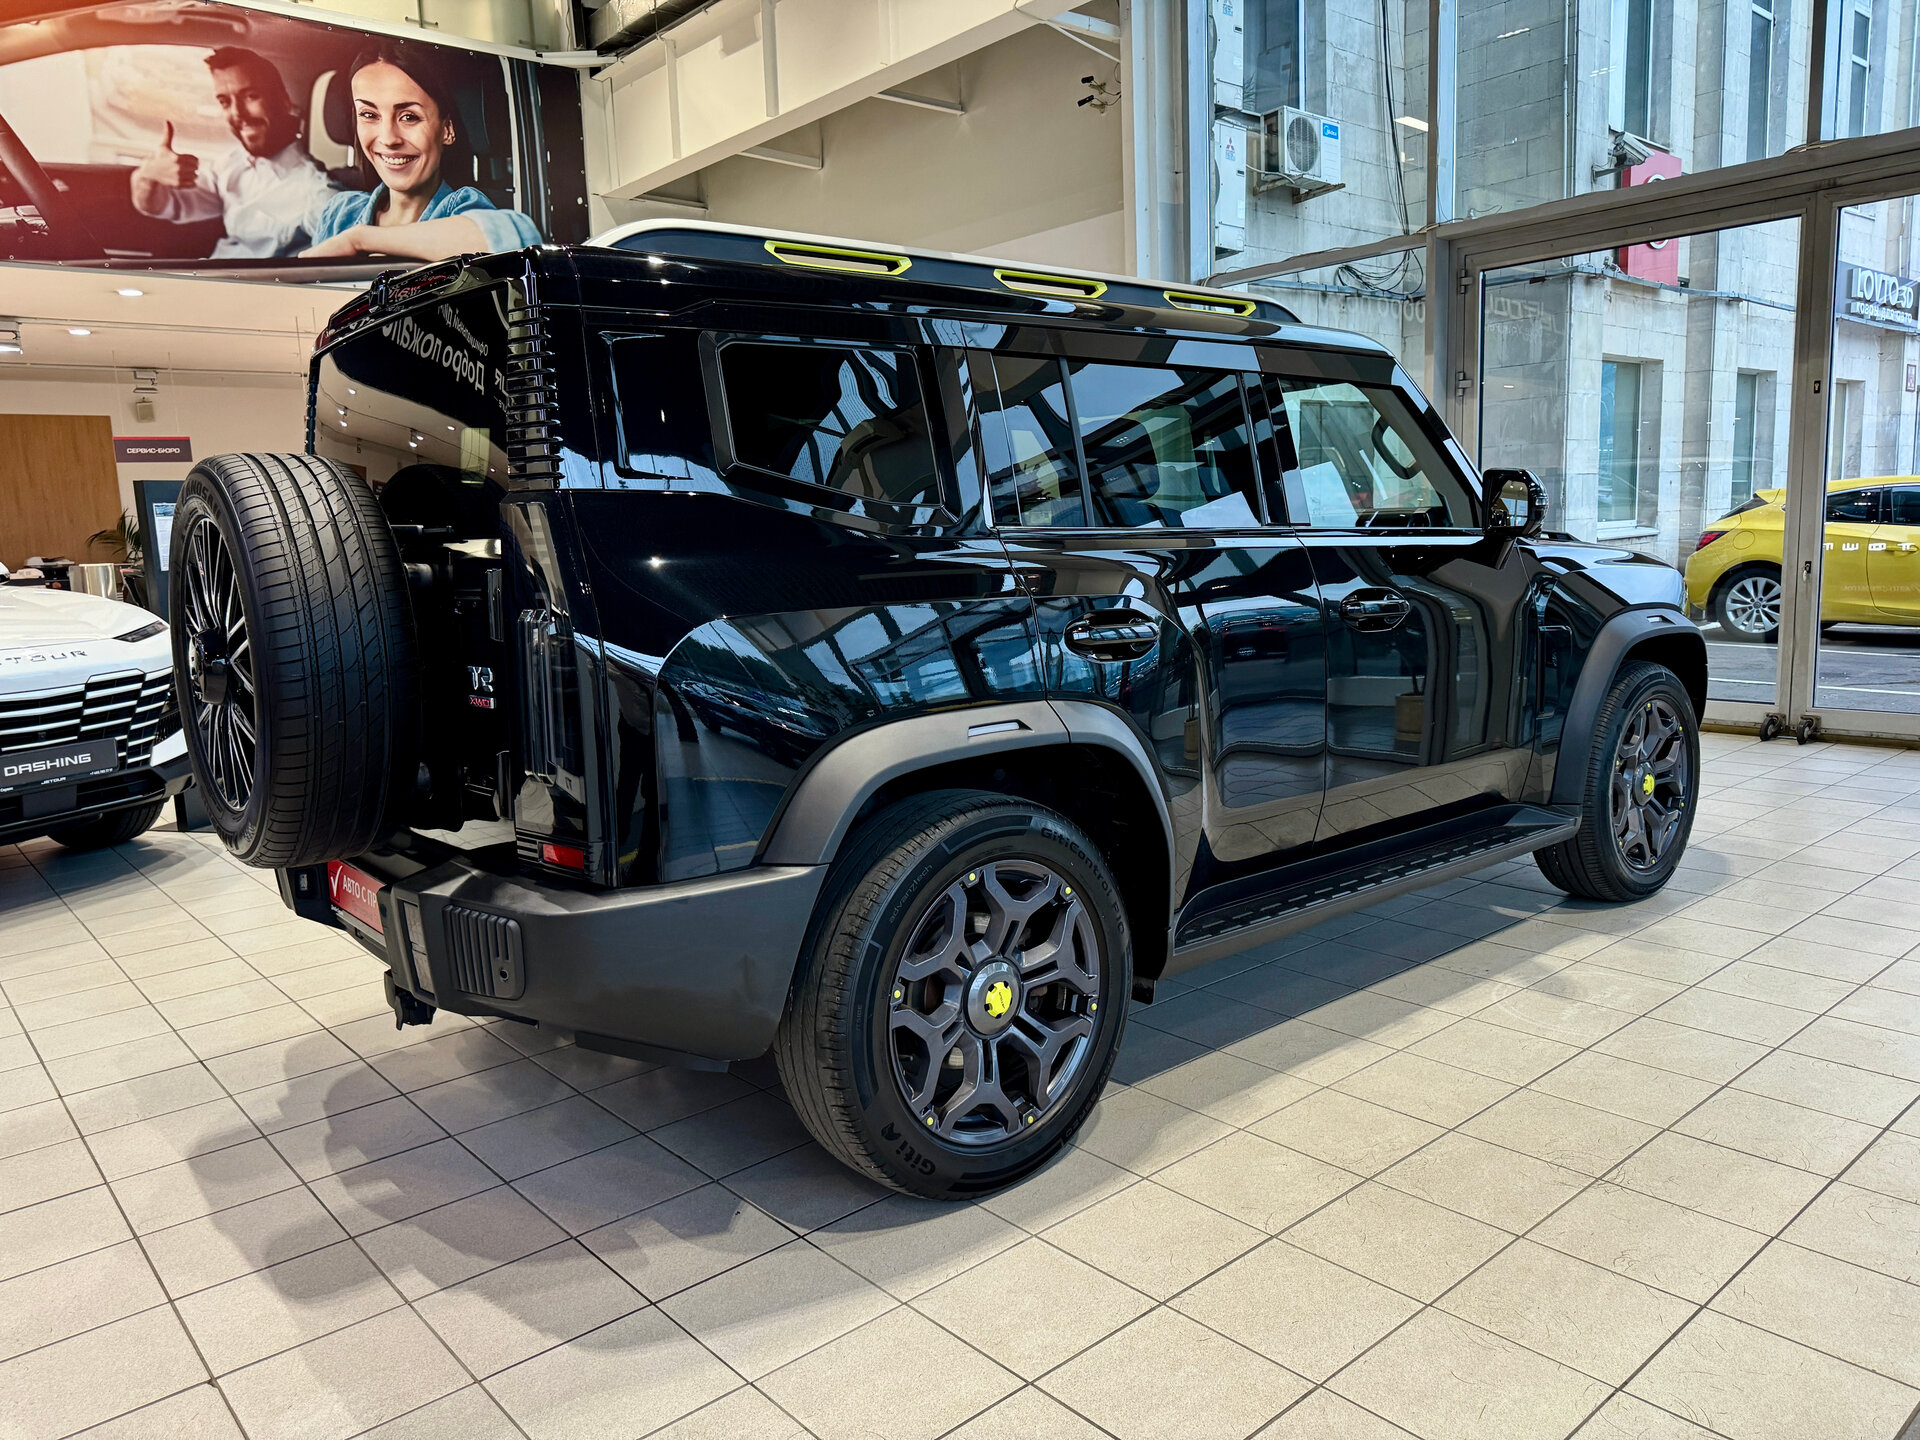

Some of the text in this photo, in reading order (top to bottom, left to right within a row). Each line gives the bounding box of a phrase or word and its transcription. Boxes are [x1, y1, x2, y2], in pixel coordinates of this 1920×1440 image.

[0, 650, 88, 666] TOUR
[3, 753, 92, 777] DASHING
[342, 875, 360, 899] АВТО
[361, 886, 367, 903] С
[895, 1140, 936, 1175] Giti
